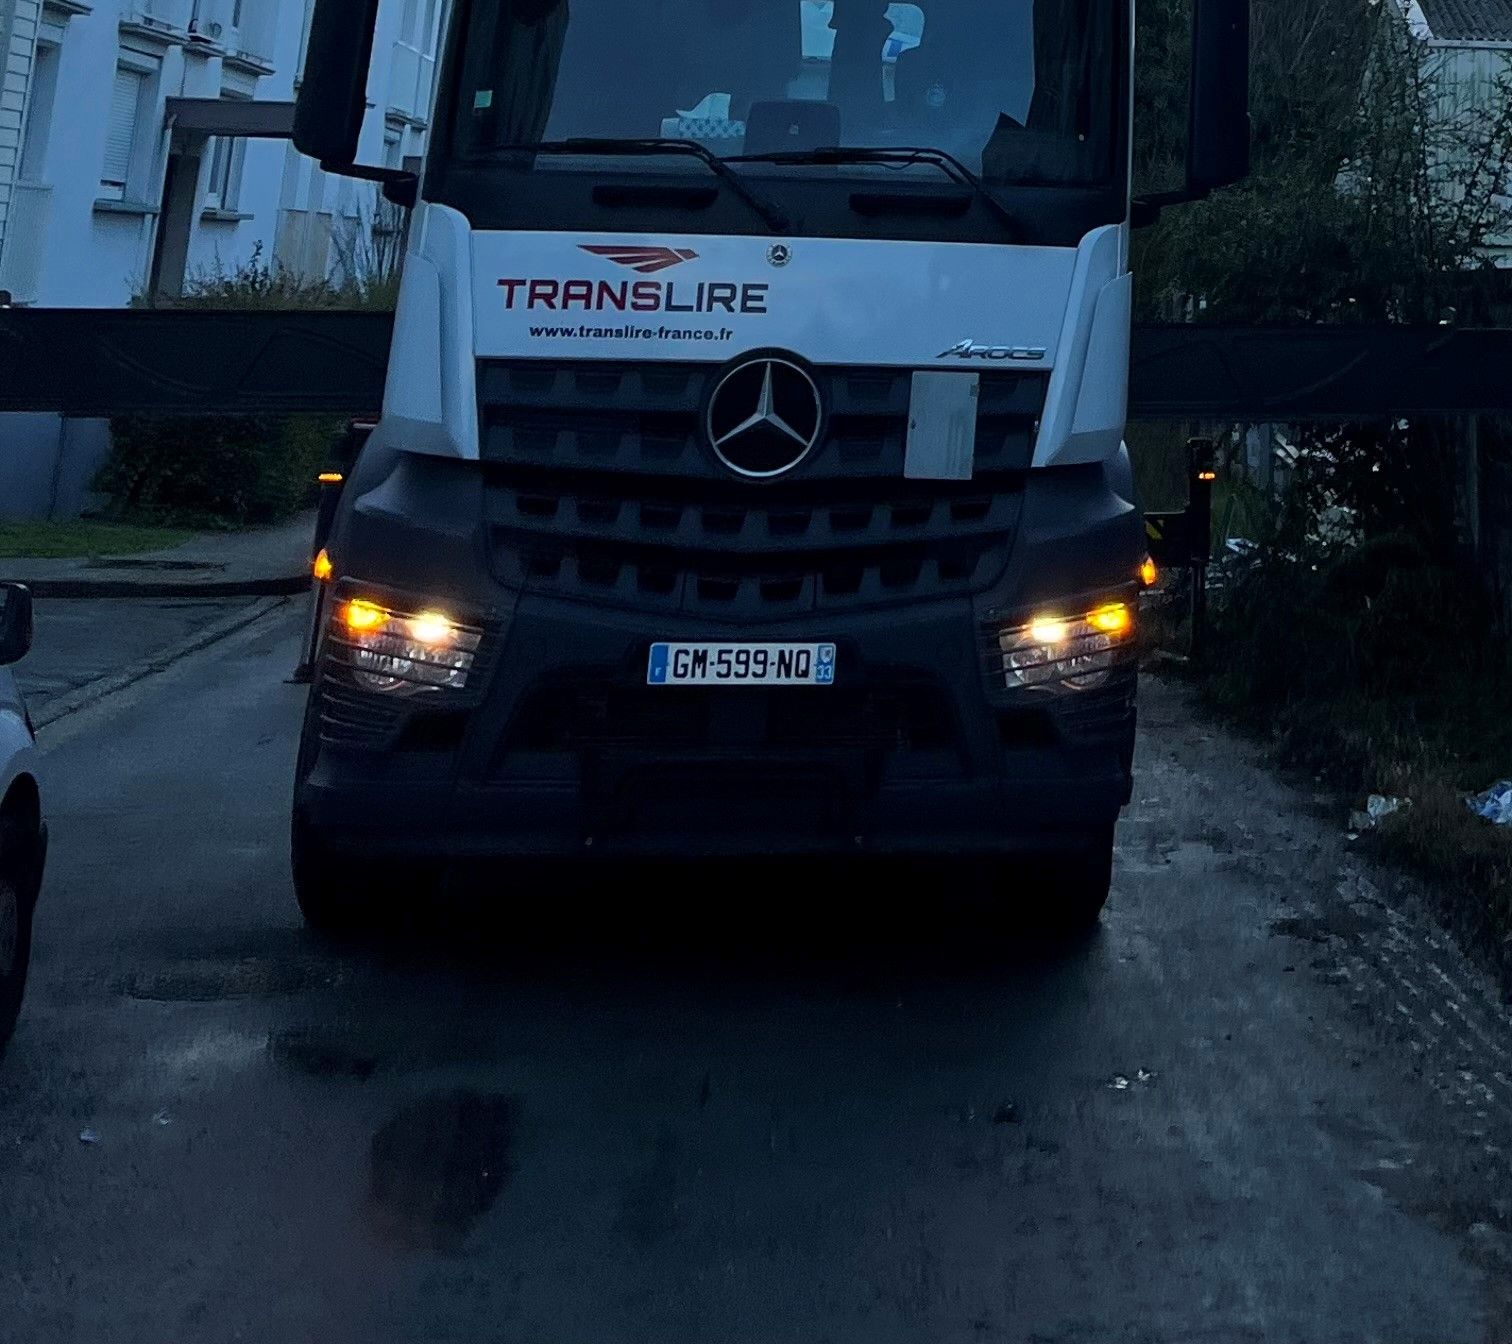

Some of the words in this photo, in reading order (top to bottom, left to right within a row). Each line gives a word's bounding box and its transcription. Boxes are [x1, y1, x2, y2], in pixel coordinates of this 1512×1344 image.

[497, 278, 769, 314] TRANSLIRE
[529, 324, 733, 341] www.translire-france.fr
[673, 649, 811, 679] GM-599-NQ
[816, 664, 831, 679] 33
